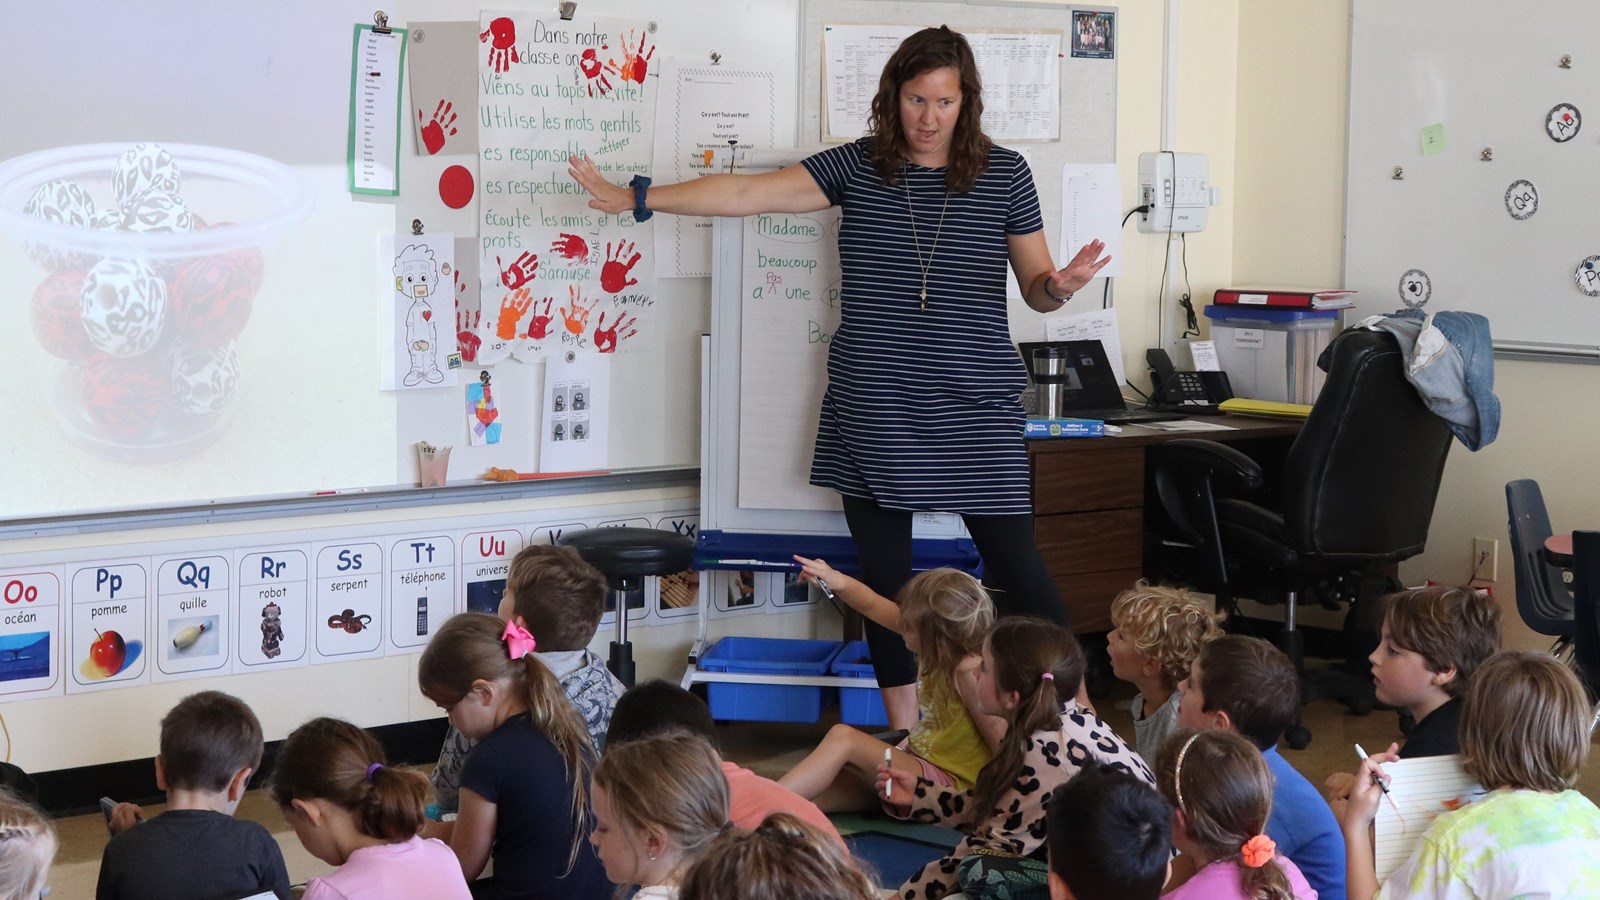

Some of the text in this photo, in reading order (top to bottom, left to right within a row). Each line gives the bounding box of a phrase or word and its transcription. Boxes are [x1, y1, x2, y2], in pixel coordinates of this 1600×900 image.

[534, 20, 608, 46] Dans notre
[519, 42, 580, 66] classe on
[481, 73, 524, 96] Viens
[530, 84, 550, 98] au
[556, 74, 586, 106] tapis
[480, 105, 642, 142] Utilise les mots gentils
[484, 141, 586, 170] es responsable
[486, 172, 588, 203] es respectueux
[486, 206, 634, 228] écoute les amis et les
[757, 214, 818, 236] Madame
[539, 260, 590, 282] S'amuse
[758, 248, 818, 274] beaucoup
[766, 272, 782, 282] Pas
[752, 286, 763, 300] a
[786, 287, 812, 300] une
[808, 320, 832, 344] Bo
[672, 520, 696, 539] Xx
[410, 542, 436, 564] Tt
[479, 536, 505, 558] Uu
[260, 556, 287, 579] Rr
[336, 550, 363, 571] Ss
[476, 564, 508, 577] univers
[96, 568, 123, 599] Pp
[177, 561, 210, 589] Qq
[330, 578, 368, 593] serpent
[400, 570, 446, 585] téléphone
[4, 579, 38, 604] Oo
[259, 586, 288, 599] robot
[91, 604, 128, 620] pomme
[180, 597, 208, 612] quille
[4, 611, 37, 625] océan
